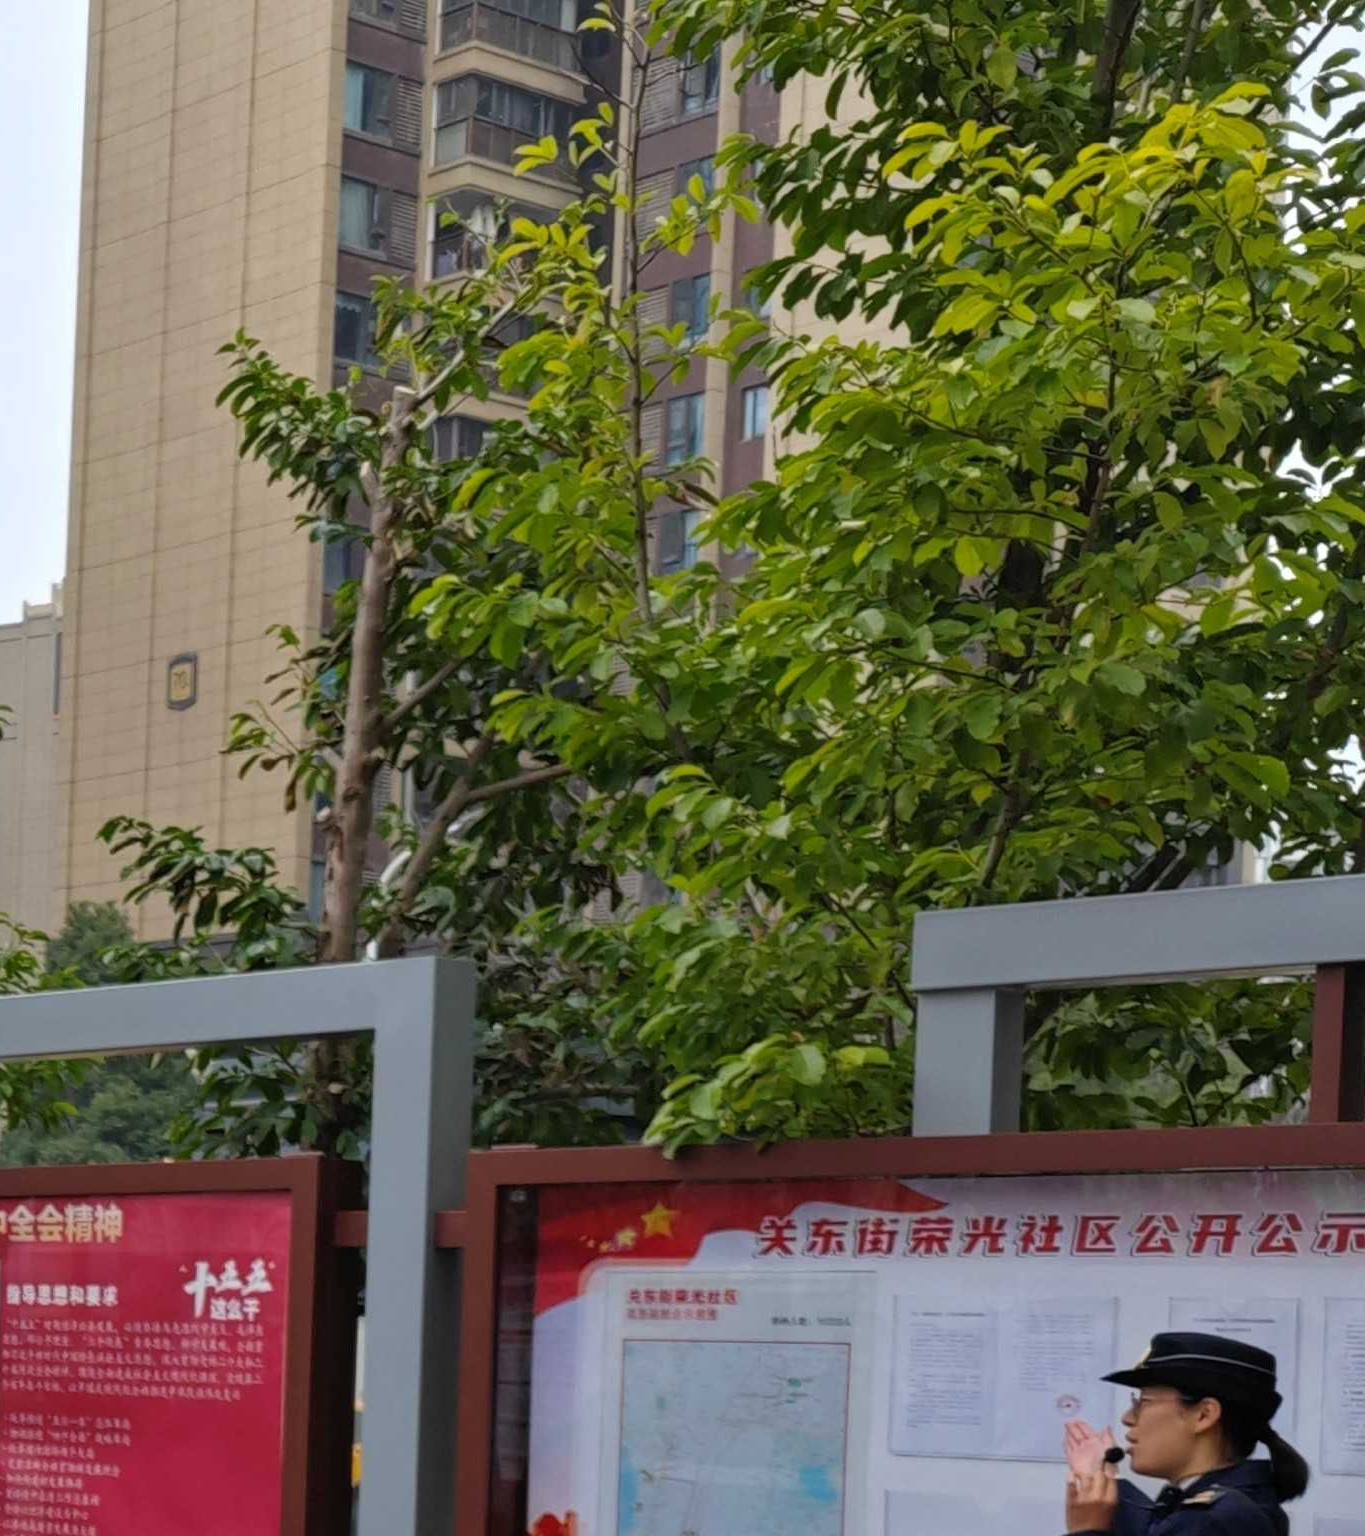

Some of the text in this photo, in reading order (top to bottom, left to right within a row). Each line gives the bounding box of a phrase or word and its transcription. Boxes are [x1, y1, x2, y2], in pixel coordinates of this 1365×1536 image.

[757, 1211, 1365, 1257] 关东街荣光社区公开公示
